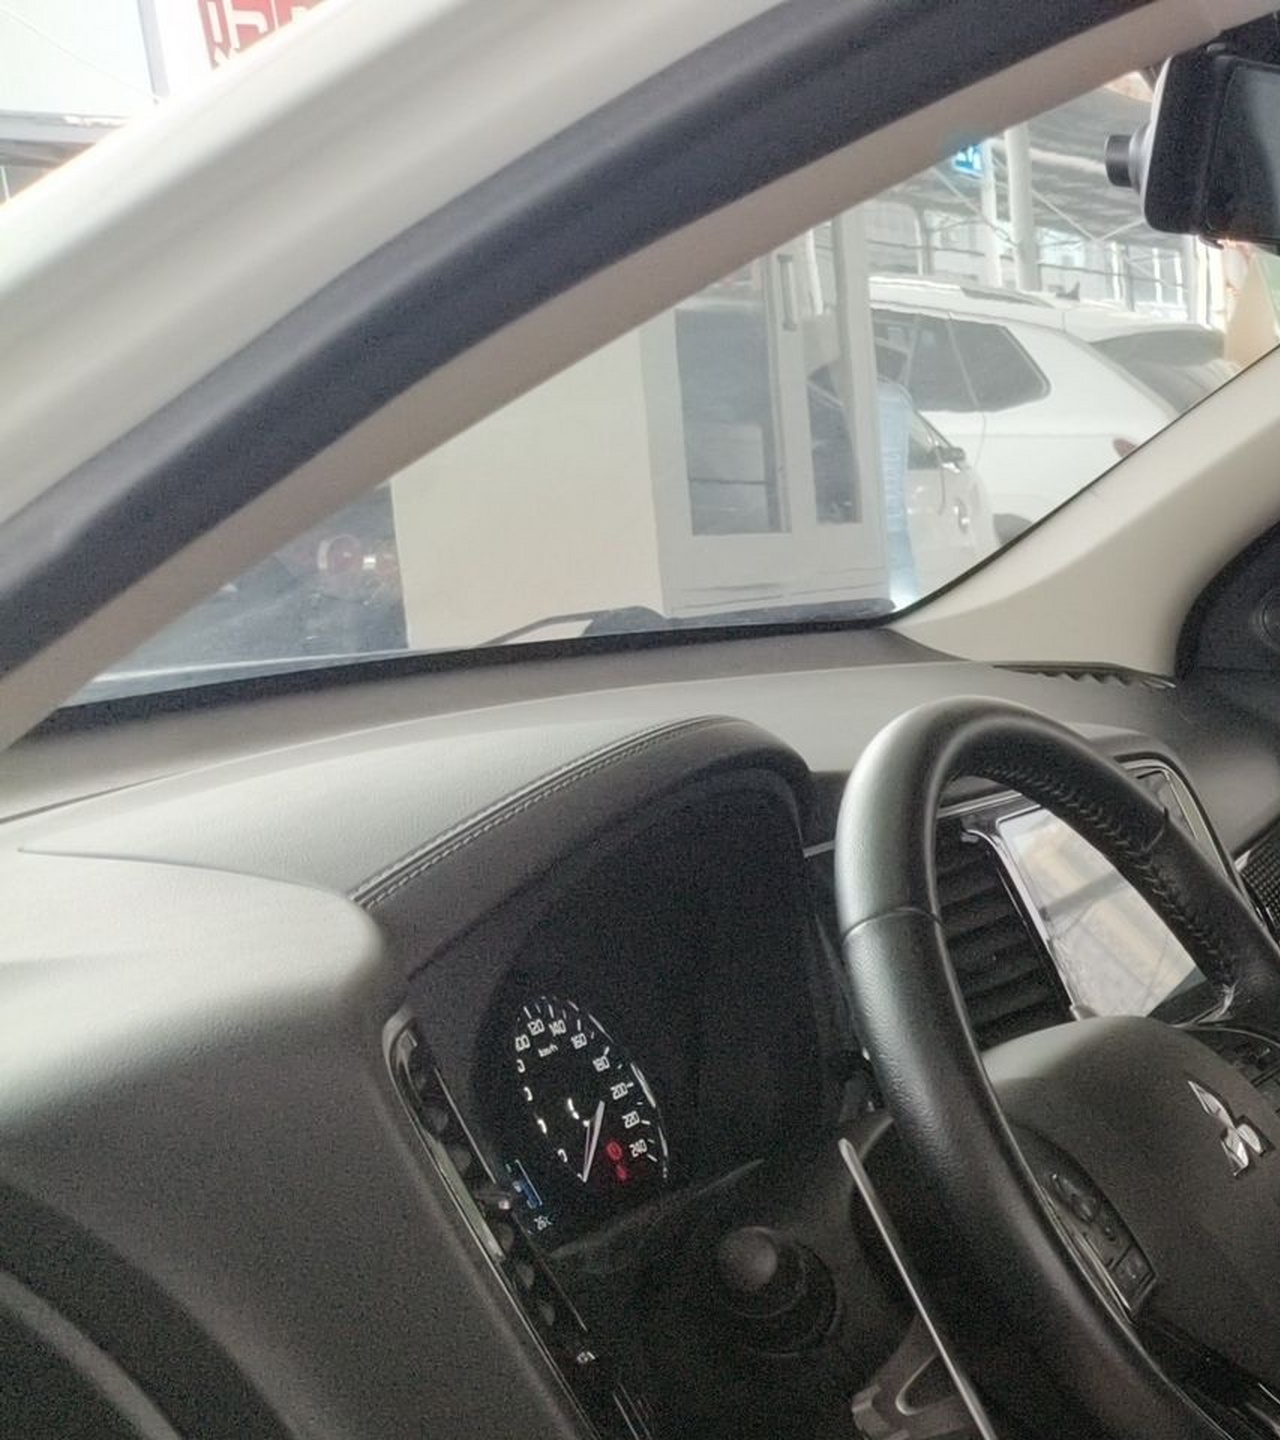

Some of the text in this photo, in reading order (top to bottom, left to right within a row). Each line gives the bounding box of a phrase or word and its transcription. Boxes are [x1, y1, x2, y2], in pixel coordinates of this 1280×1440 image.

[528, 1018, 546, 1036] 120
[610, 1082, 629, 1101] 200
[622, 1110, 640, 1129] 220
